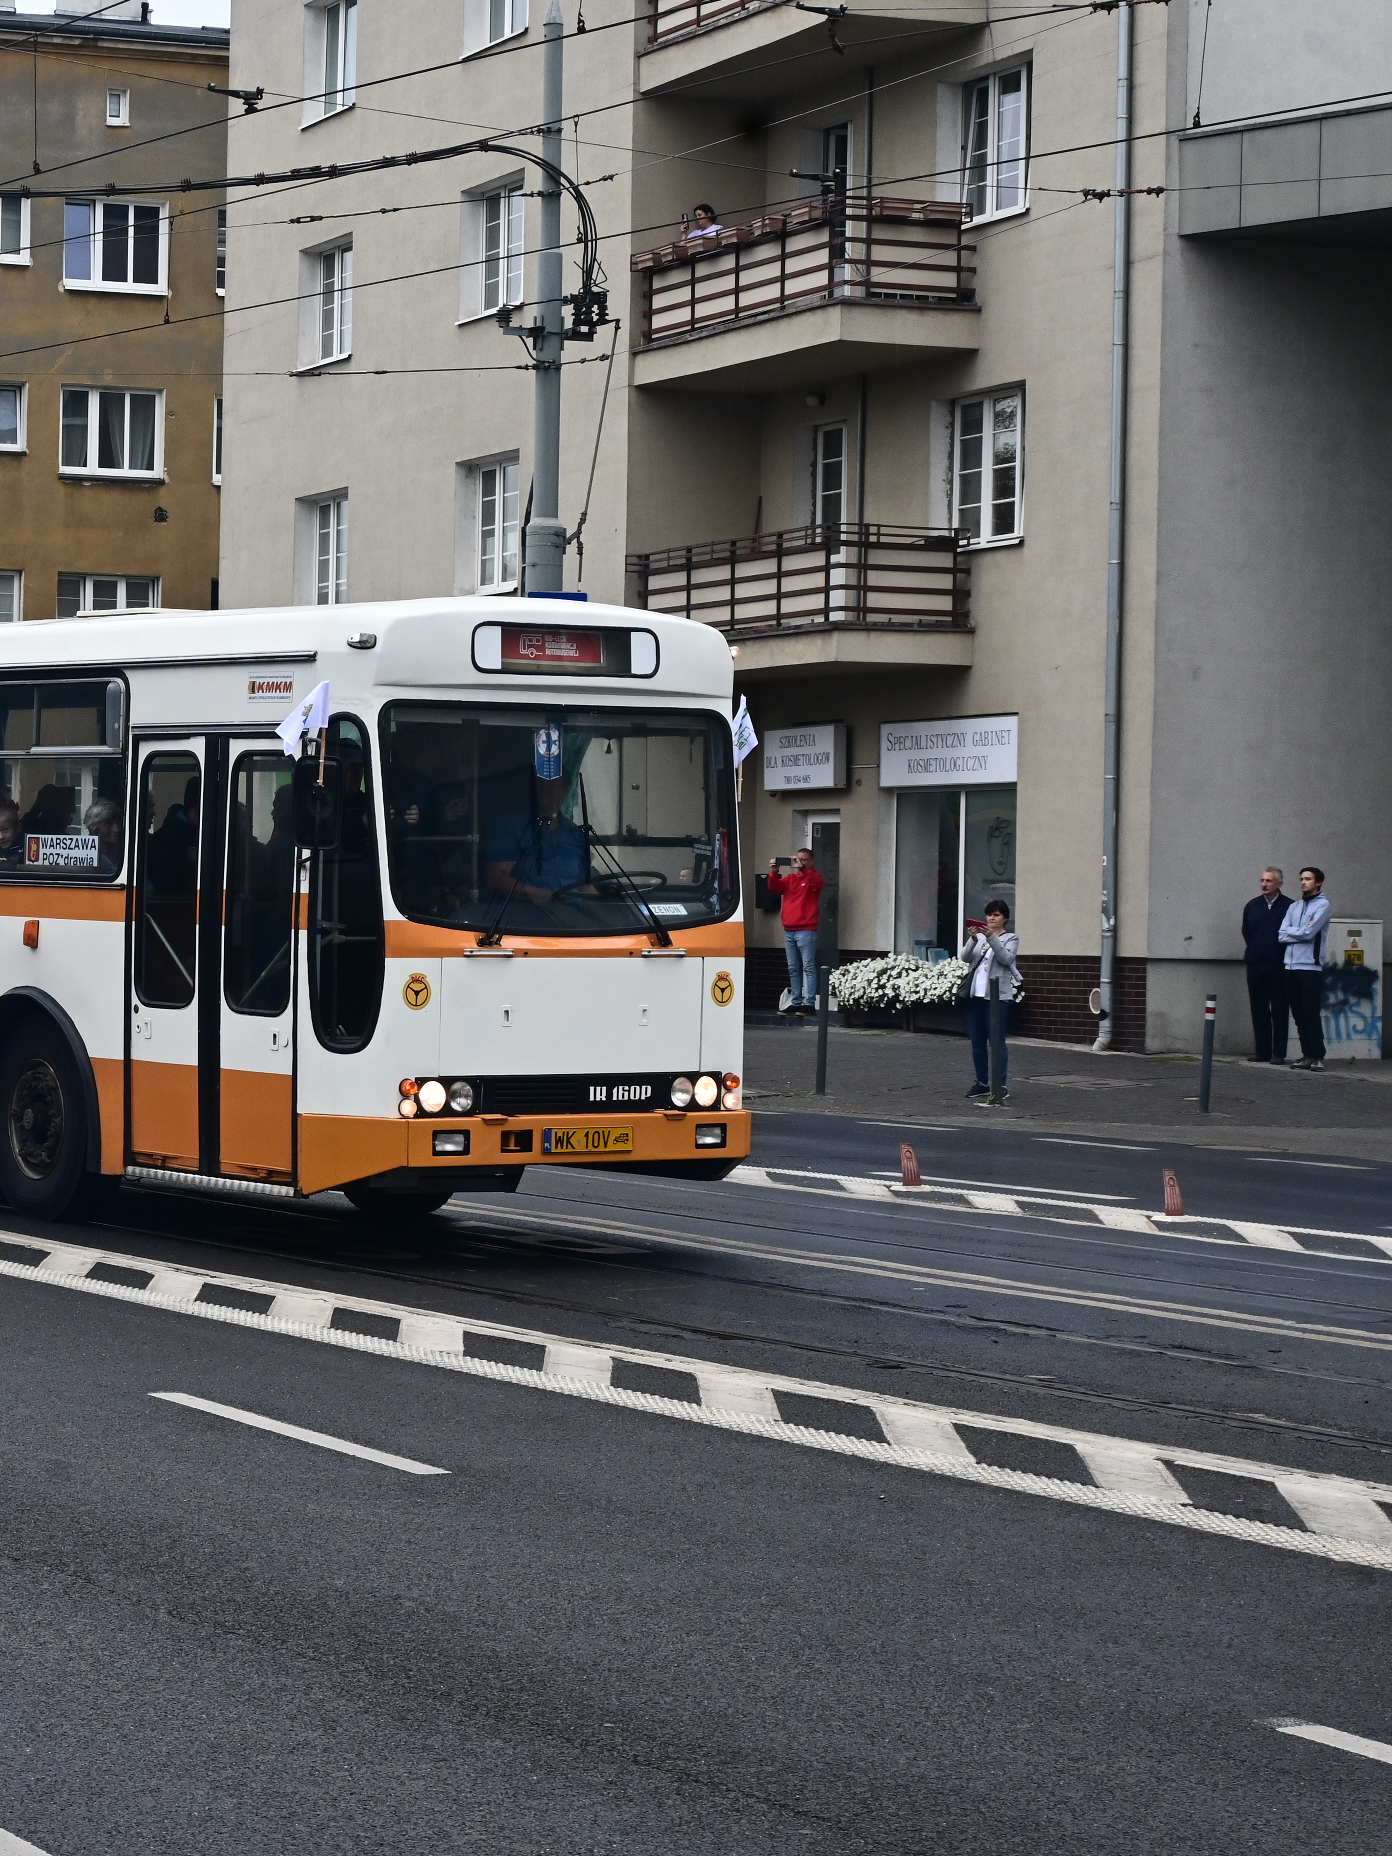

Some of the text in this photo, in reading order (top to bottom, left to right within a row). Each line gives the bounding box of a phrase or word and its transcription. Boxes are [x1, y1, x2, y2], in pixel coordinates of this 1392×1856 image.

[256, 681, 293, 694] KMKM
[779, 733, 816, 749] SZKOLENIA
[887, 729, 1013, 751] SPECJALISTYCZNY GABINET
[765, 756, 778, 768] DLA
[907, 755, 989, 774] KOSMETOLOGICZNY
[41, 836, 97, 851] WARSZAWA
[554, 1130, 576, 1149] WK
[583, 1130, 611, 1149] 10V
